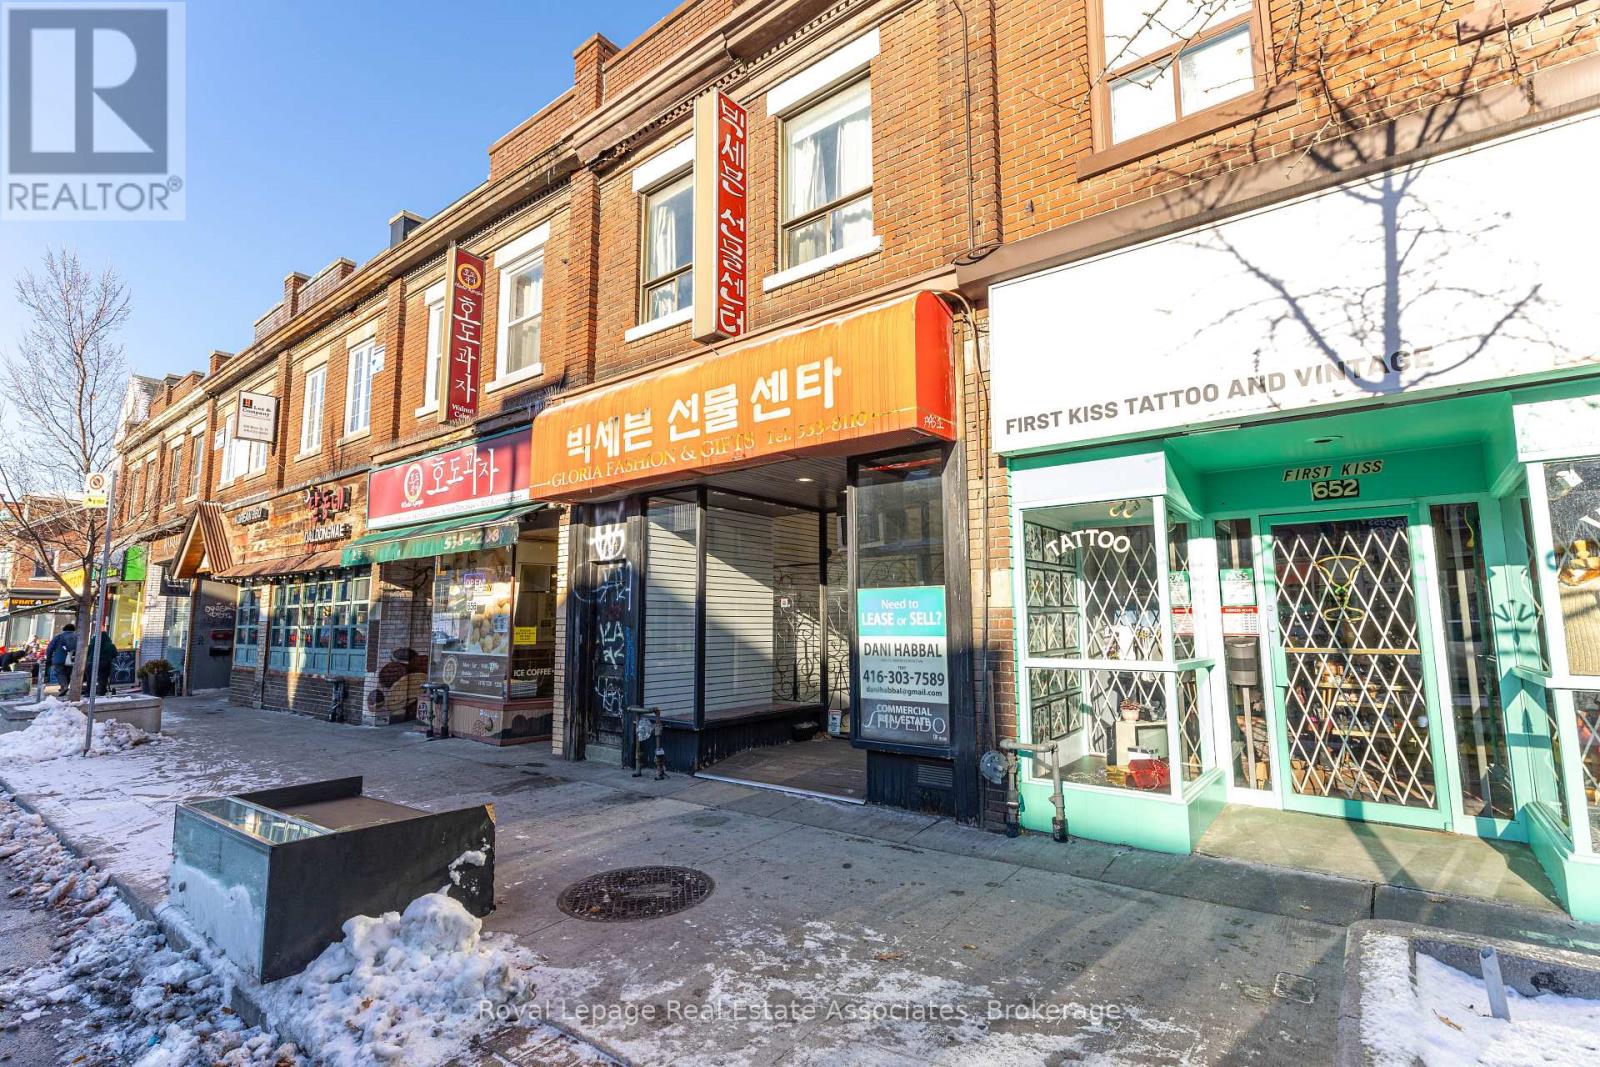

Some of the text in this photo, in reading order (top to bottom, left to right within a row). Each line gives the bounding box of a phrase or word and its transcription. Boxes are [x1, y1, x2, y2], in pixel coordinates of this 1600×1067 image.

[453, 295, 482, 404] 호도과자
[1006, 346, 1434, 435] FIRST KISS TATTOO AND VINTAGE
[452, 403, 474, 414] Walnut
[566, 356, 842, 464] 빅세븐 선물 센타
[551, 465, 603, 487] GLORIA
[606, 450, 676, 477] FASHION
[680, 446, 697, 461] &
[700, 432, 755, 458] GIFTS
[426, 446, 500, 496] 호도과자
[1284, 460, 1383, 482] FIRST KISS
[1313, 479, 1359, 499] 652
[1045, 529, 1131, 557] TATTOO
[881, 598, 919, 609] Need to
[861, 611, 942, 626] LEASE or SELL?
[864, 642, 942, 658] DANI HABBAL
[513, 668, 552, 677] ICE COFFEE
[863, 669, 945, 686] 416-303-7589
[866, 686, 942, 697] danihabbal@gmail.com
[876, 704, 933, 717] COMMERCIAL
